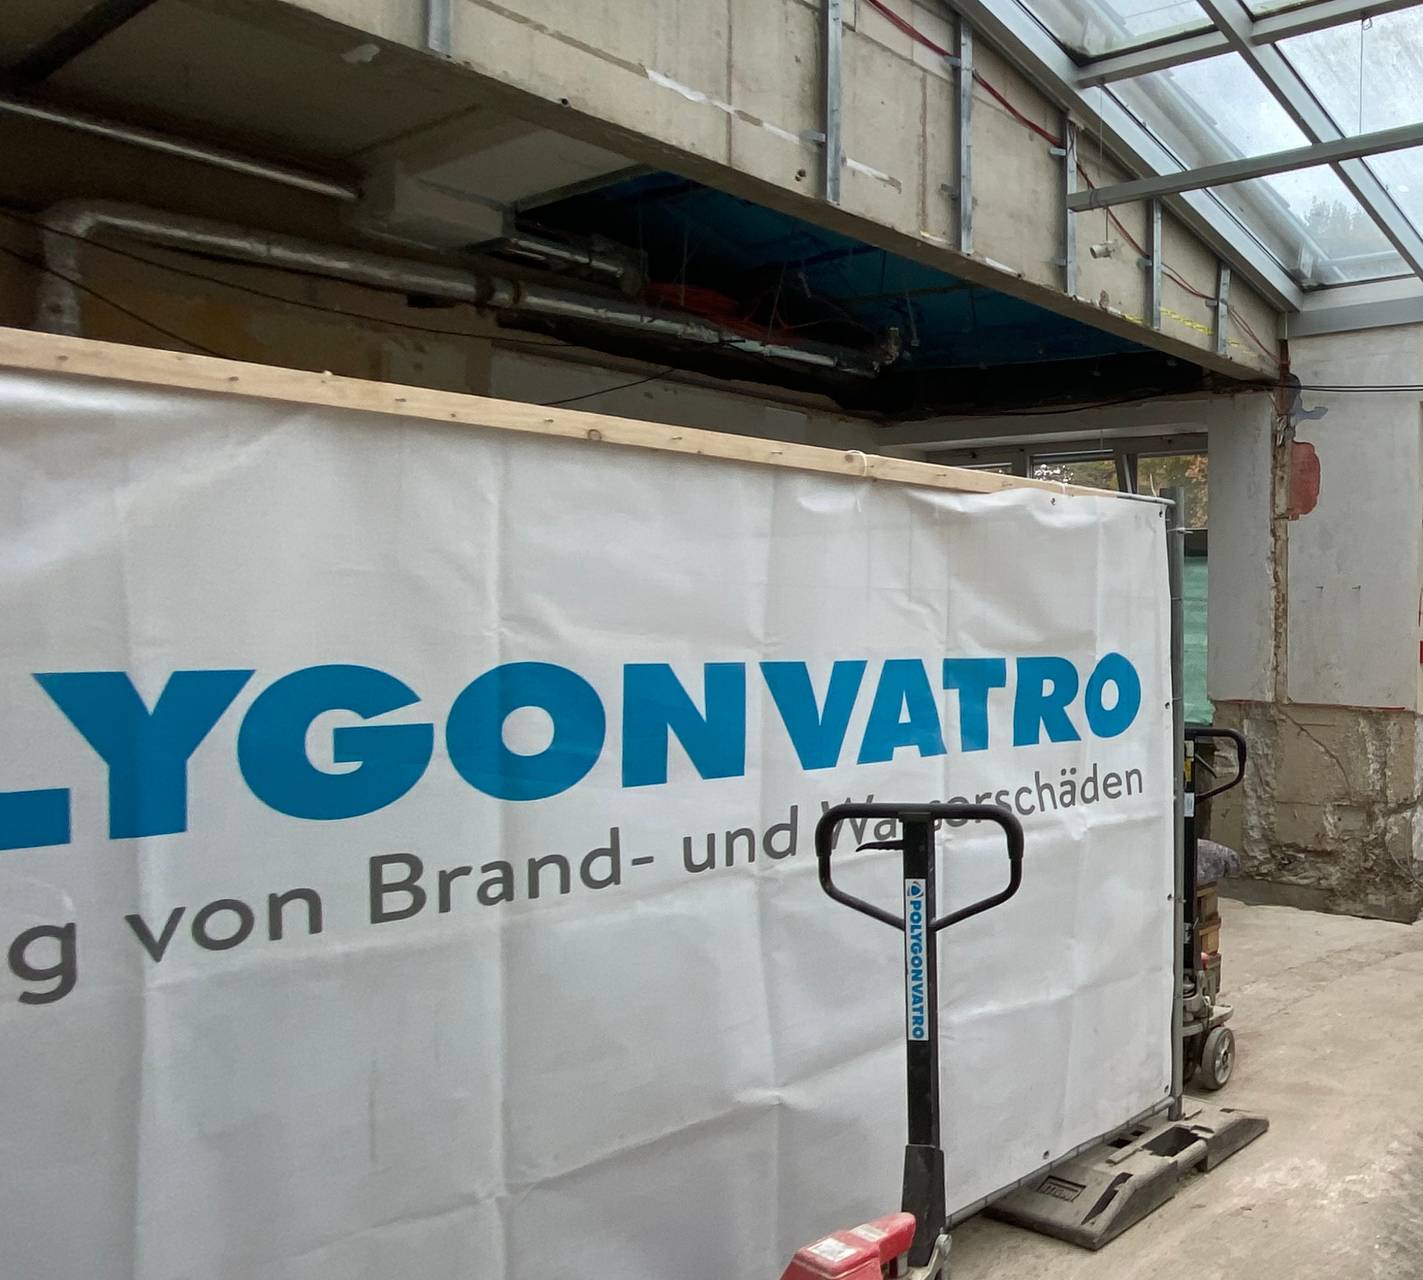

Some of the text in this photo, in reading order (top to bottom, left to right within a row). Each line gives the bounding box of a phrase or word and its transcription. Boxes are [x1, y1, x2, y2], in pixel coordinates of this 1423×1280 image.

[0, 652, 1142, 851] YGONVATRO
[124, 887, 322, 963] von
[369, 827, 655, 925] Brand-
[682, 805, 798, 873] und
[910, 899, 925, 1039] POLYGONVATRO
